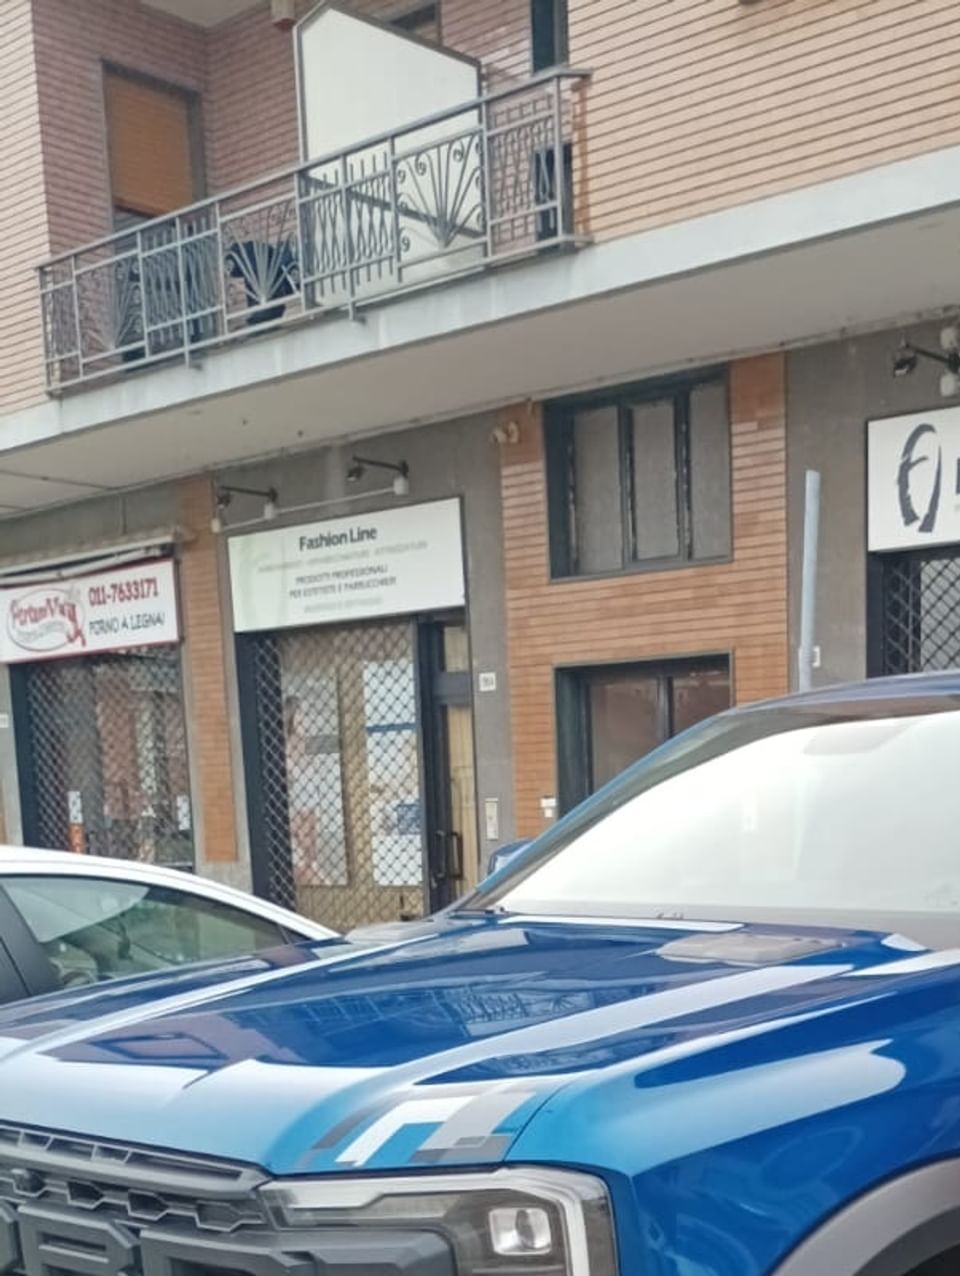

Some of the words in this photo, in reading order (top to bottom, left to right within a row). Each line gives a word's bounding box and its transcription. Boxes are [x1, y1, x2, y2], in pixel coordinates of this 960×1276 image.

[299, 531, 348, 552] Fashion
[349, 526, 378, 544] Line
[88, 576, 158, 607] 011-7633171
[121, 615, 129, 630] A
